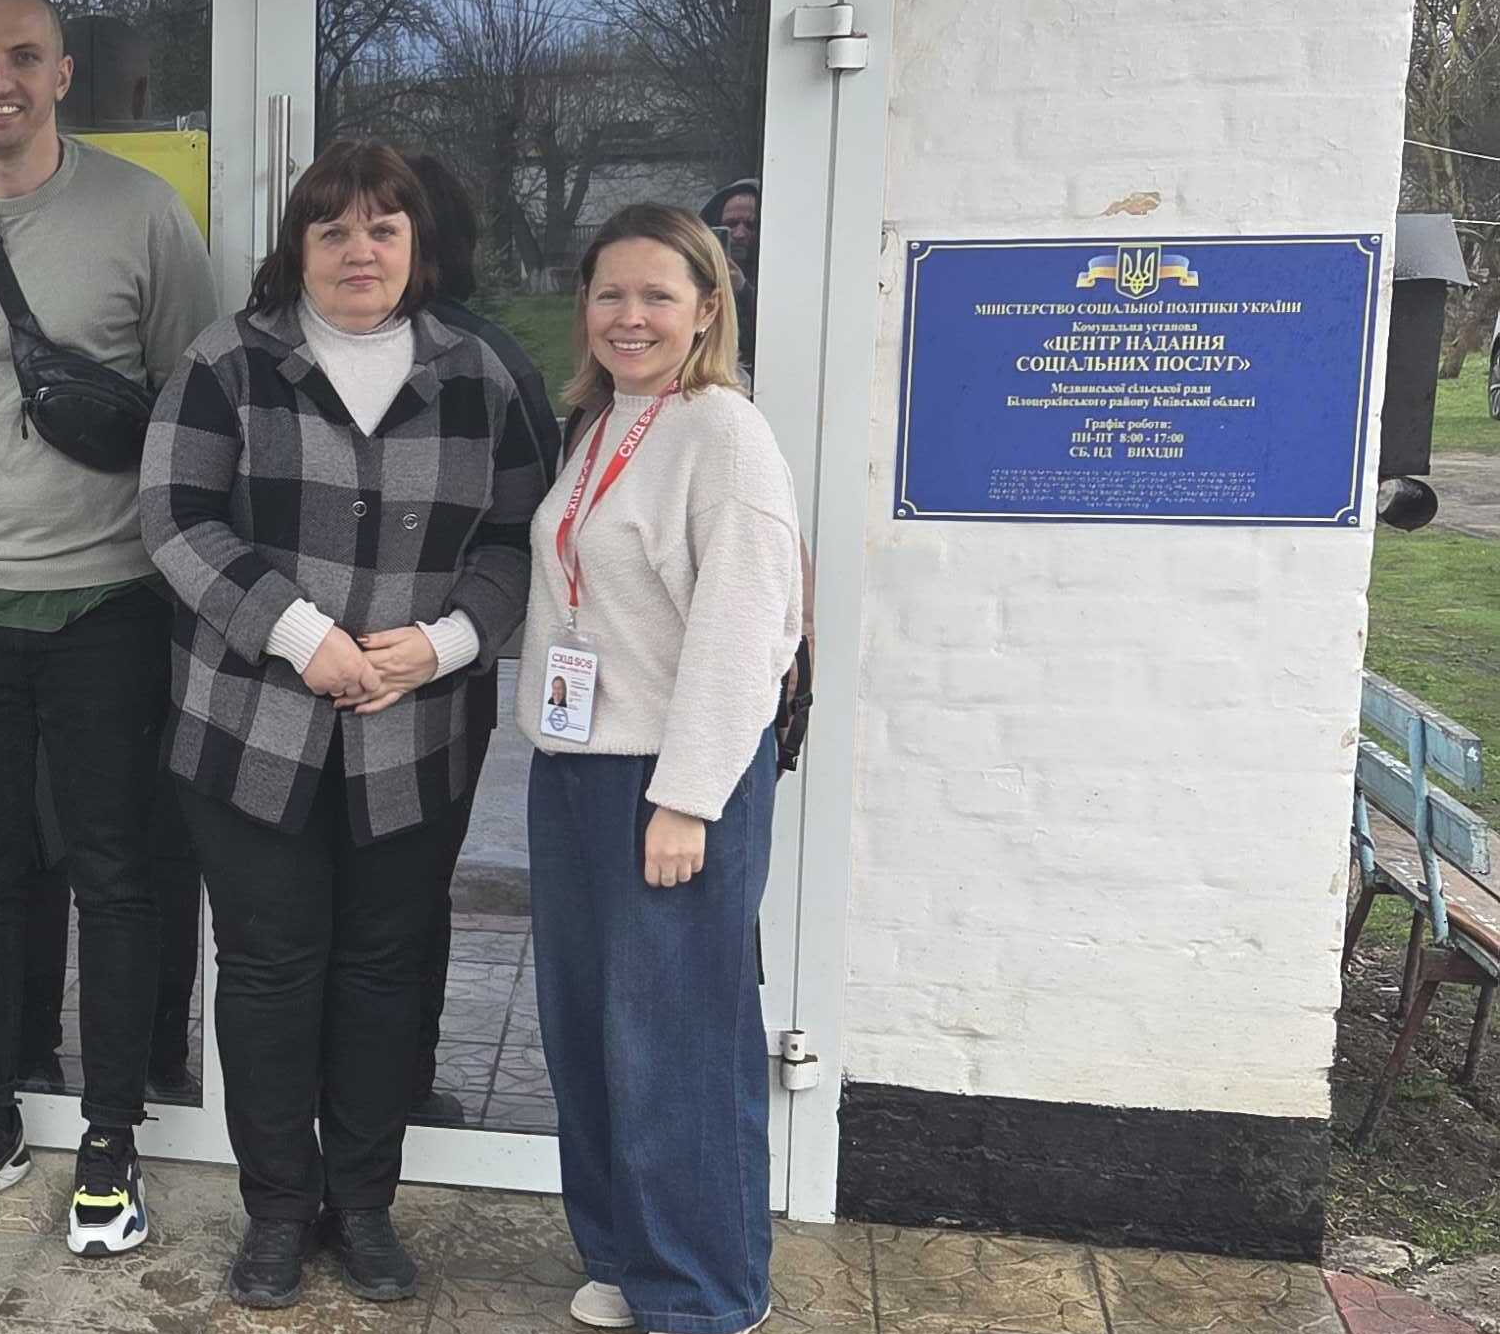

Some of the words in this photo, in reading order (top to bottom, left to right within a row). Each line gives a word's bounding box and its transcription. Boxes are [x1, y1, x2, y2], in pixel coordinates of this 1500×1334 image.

[974, 303, 1075, 316] МІНІСТЕРСТВО
[1077, 301, 1163, 315] СОЦІАЛЬНОЇ
[1166, 302, 1237, 314] ПОЛІТИКИ
[1242, 299, 1301, 314] УКРАЇНИ
[1072, 321, 1143, 334] Комунальна
[1145, 323, 1198, 334] установа
[1043, 335, 1121, 352] «ЦЕНТР
[1126, 335, 1225, 352] НАДАННЯ
[1016, 355, 1150, 373] СОЦІАЛЬНИХ
[1155, 355, 1251, 372] ПОСЛУГ»
[1050, 382, 1125, 394] Медвинської
[1127, 383, 1181, 394] сільської
[1183, 384, 1211, 397] ради
[1007, 395, 1107, 409] Білоцерківського
[1109, 396, 1150, 409] району
[1153, 396, 1210, 407] Київської
[1212, 396, 1255, 407] області
[1084, 417, 1125, 431] Графік
[1127, 418, 1172, 431] роботи:
[619, 424, 645, 458] СХІД
[1071, 432, 1114, 443] ПН-ПТ
[1119, 432, 1143, 444] 8:00
[1154, 433, 1184, 444] 17:00
[1127, 447, 1184, 459] ВИХІДНІ
